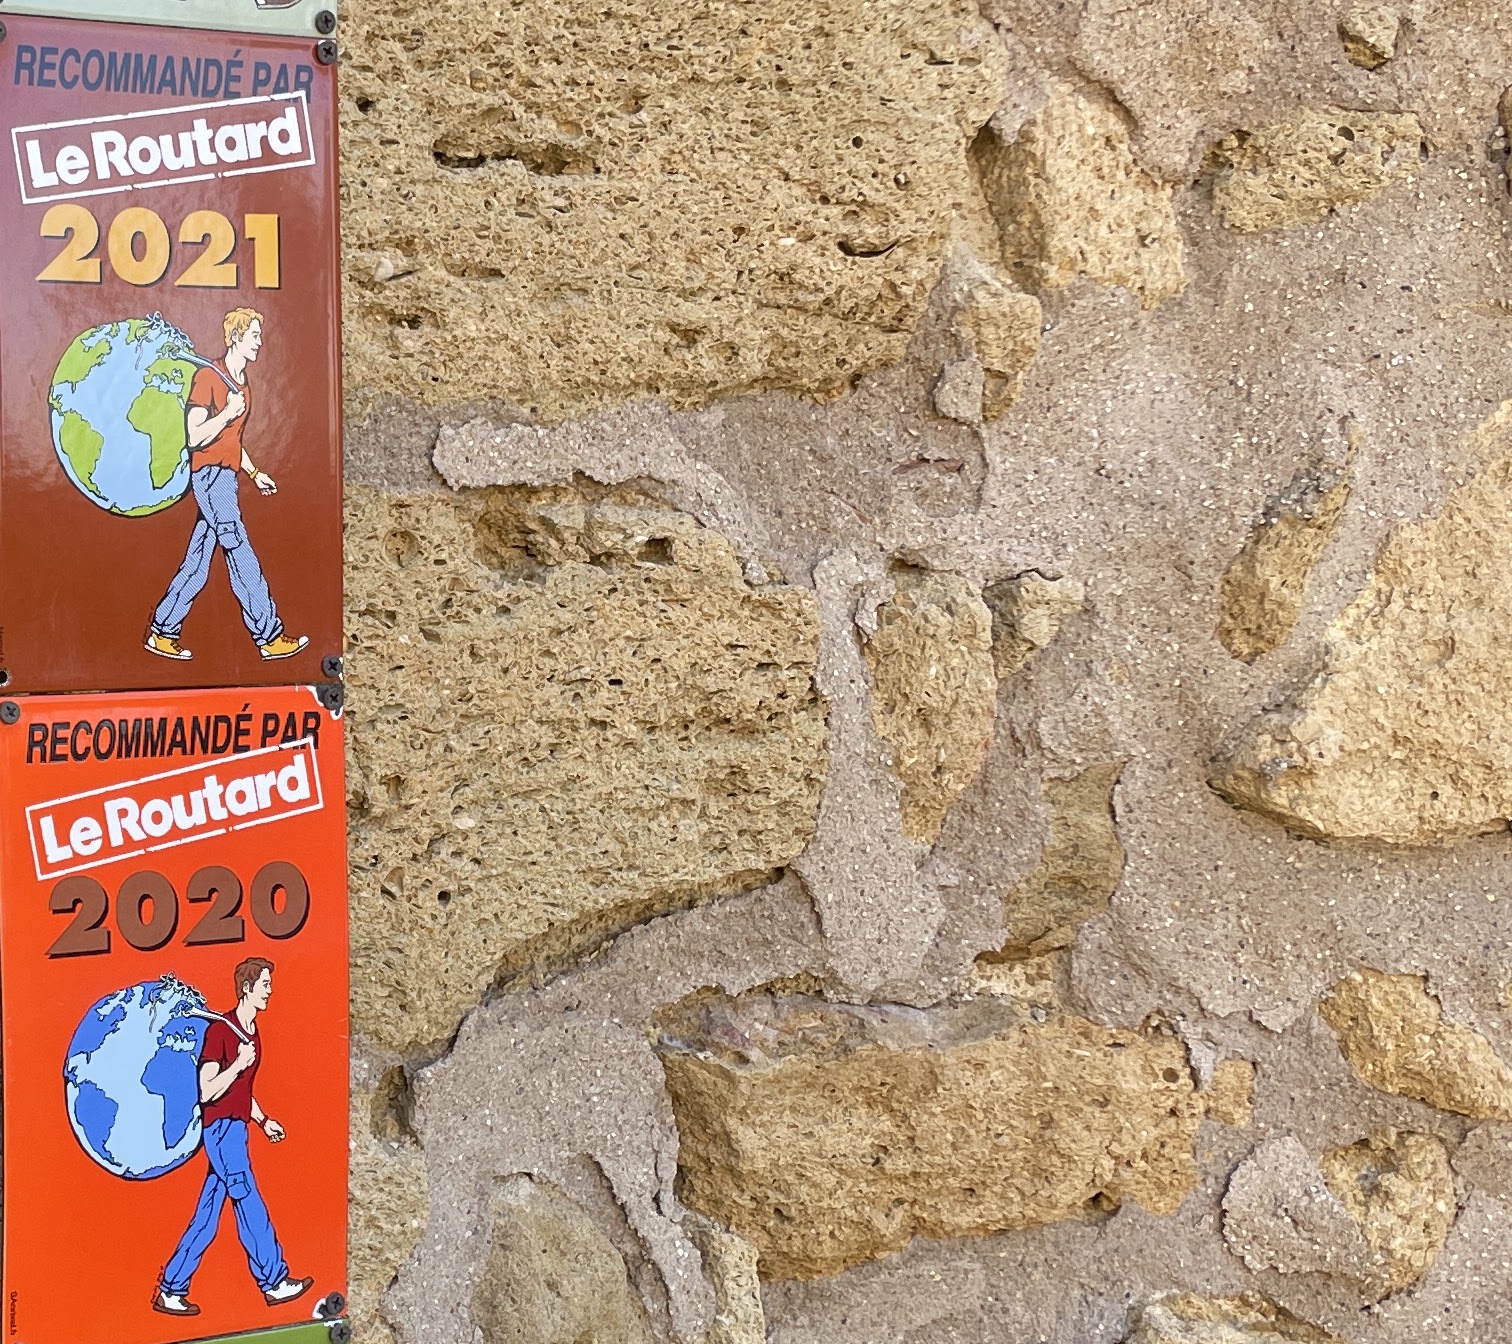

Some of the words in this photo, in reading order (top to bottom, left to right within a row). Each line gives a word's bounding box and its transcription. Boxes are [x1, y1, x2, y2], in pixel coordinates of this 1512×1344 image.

[14, 44, 244, 99] RECOMMANDÉ
[252, 63, 314, 104] PAR
[35, 204, 283, 290] 2021
[26, 704, 253, 764] RECOMMANDÉ
[260, 711, 321, 750] PAR
[44, 861, 310, 960] 2020
